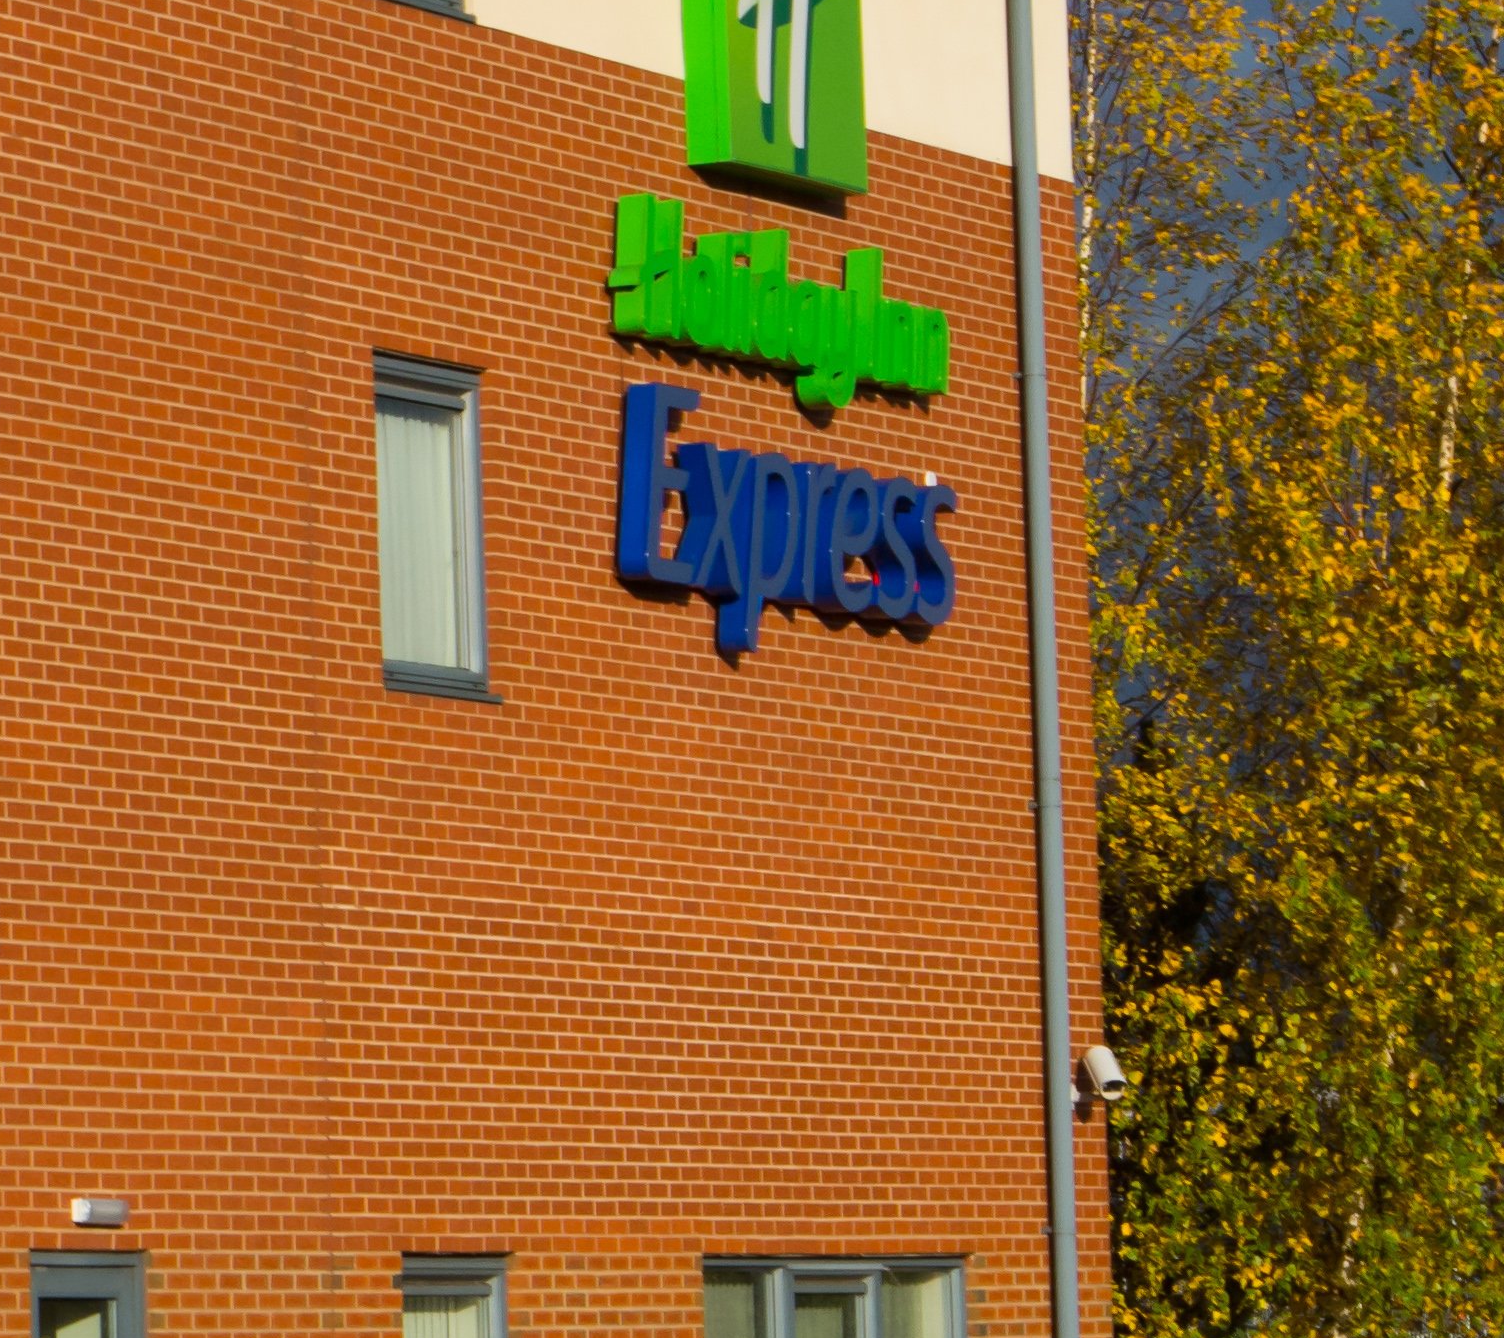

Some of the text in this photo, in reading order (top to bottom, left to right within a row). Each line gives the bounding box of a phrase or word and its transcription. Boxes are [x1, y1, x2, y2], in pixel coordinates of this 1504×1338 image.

[607, 192, 951, 410] Holiday Inn
[618, 381, 957, 652] Express
